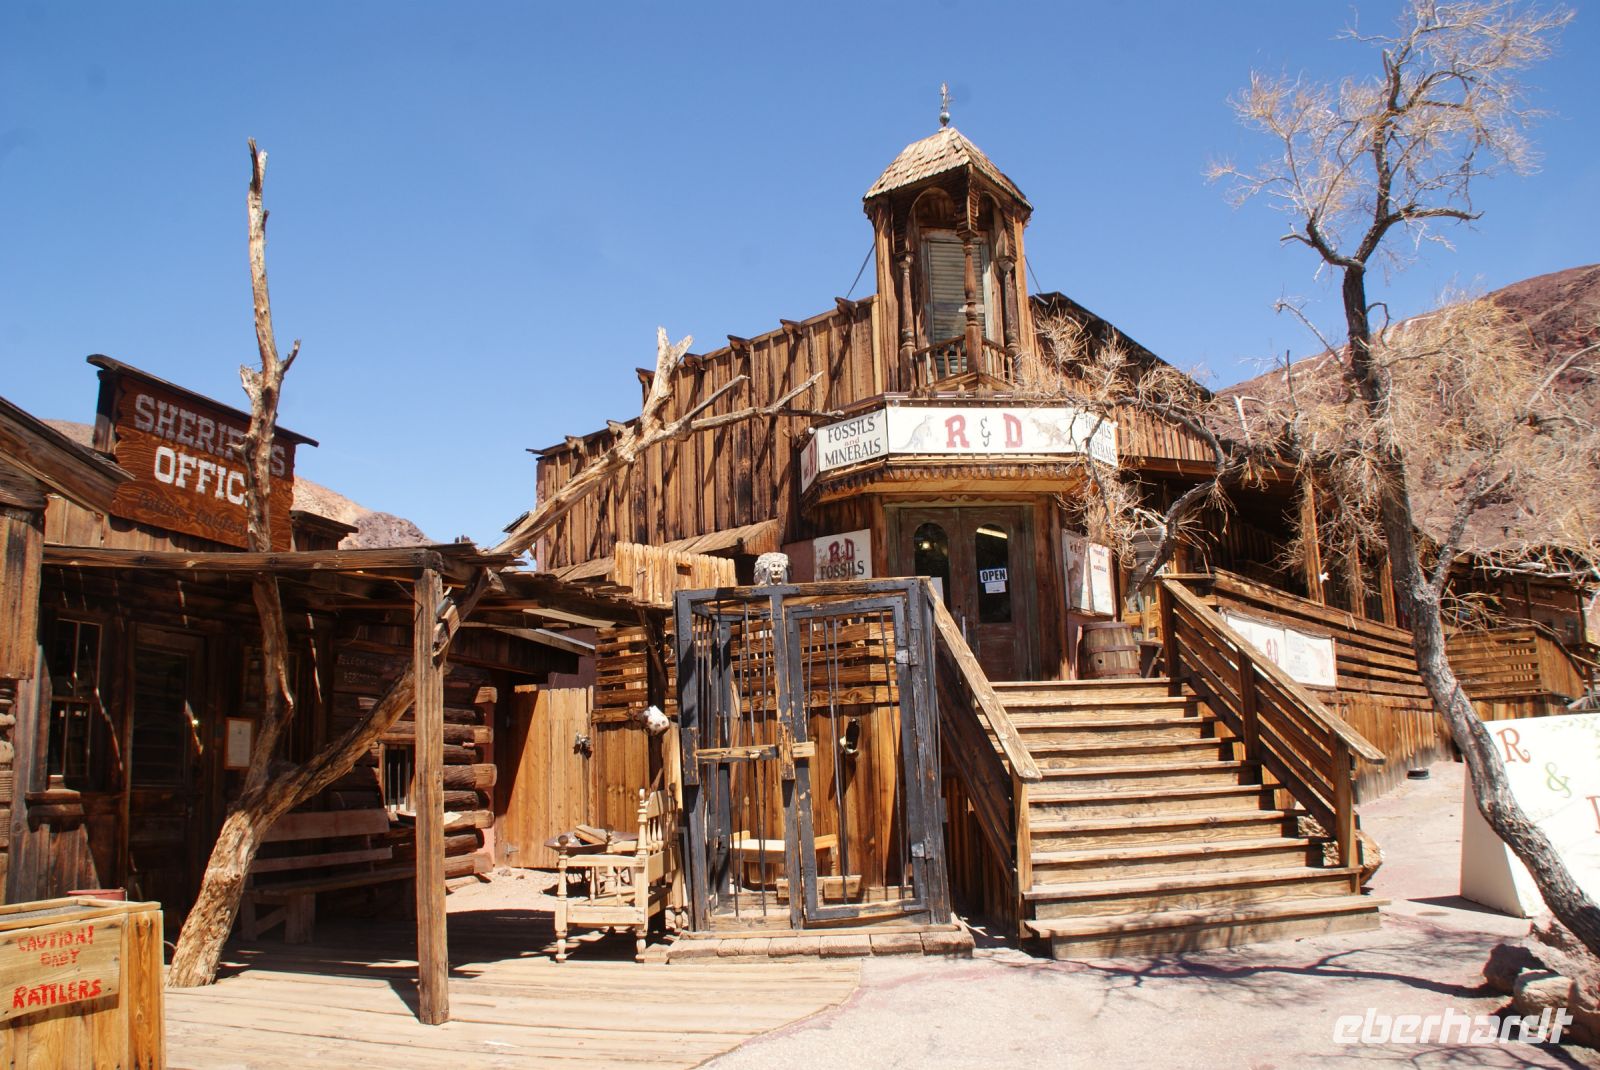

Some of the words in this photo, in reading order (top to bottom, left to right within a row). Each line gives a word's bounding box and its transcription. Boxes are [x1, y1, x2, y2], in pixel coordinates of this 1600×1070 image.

[134, 393, 286, 478] SHERIFS
[827, 416, 876, 443] FOSSILS
[844, 437, 860, 446] and
[945, 414, 970, 448] R
[980, 416, 991, 447] &
[1003, 413, 1023, 448] D
[824, 437, 882, 467] MINERALS
[154, 446, 249, 507] OFFIC
[820, 560, 865, 580] FOSSILS
[982, 569, 1006, 581] OPEN
[1496, 727, 1531, 764] R
[1545, 761, 1573, 799] &
[16, 925, 94, 951] CAUTION!
[12, 979, 102, 1009] RATTLERS
